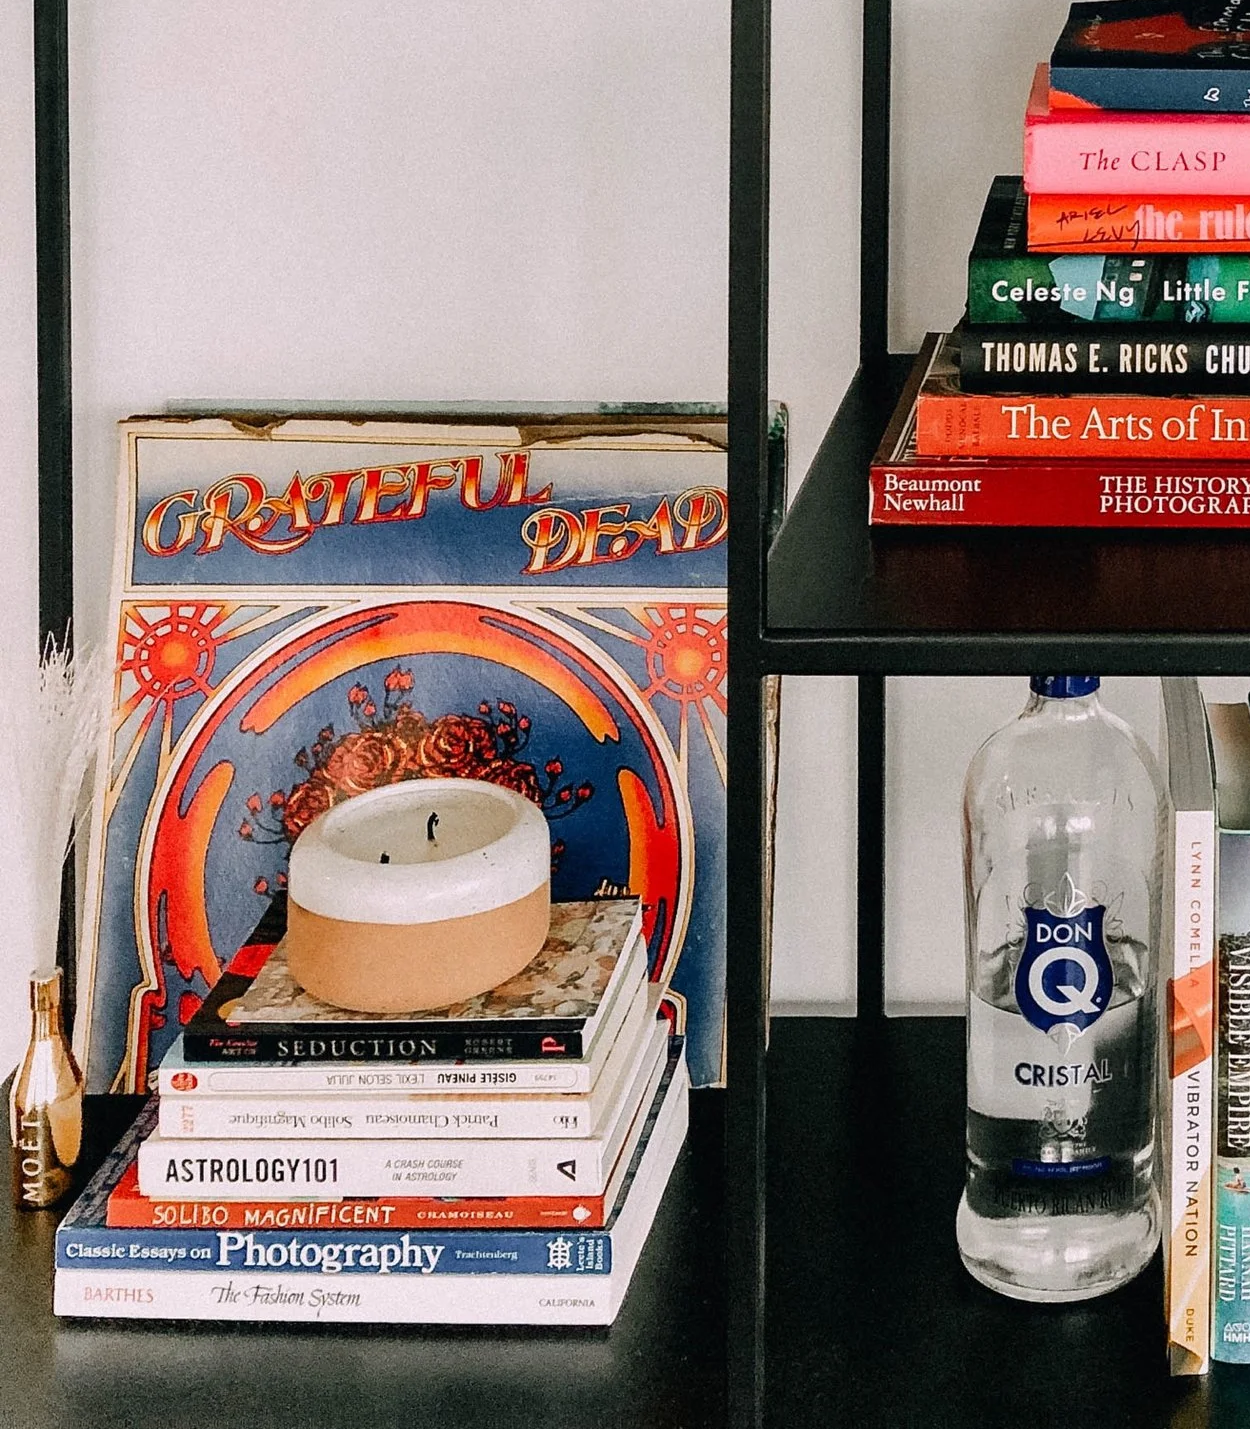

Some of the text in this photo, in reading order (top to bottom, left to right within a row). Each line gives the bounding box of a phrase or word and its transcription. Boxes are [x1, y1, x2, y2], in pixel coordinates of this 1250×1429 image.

[1080, 151, 1122, 172] The
[1131, 151, 1227, 173] CLASP
[1134, 204, 1183, 242] the
[991, 280, 1088, 304] Celeste
[1097, 280, 1135, 307] Ng
[1163, 278, 1227, 303] Little
[981, 341, 1078, 374] THOMAS
[1089, 343, 1109, 374] E.
[1119, 342, 1189, 374] RICKS
[1001, 404, 1071, 441] The
[1080, 406, 1153, 442] Arts
[1163, 403, 1205, 442] of
[883, 473, 982, 493] Beaumont
[1099, 475, 1149, 497] THE
[141, 450, 729, 575] GRATEFUL DEAD
[883, 493, 965, 513] Newhall
[1188, 840, 1202, 989] LYNN COMELLA
[1036, 922, 1093, 943] DON
[1028, 946, 1101, 1016] Q
[277, 1037, 438, 1058] SEDUCTION
[1014, 1058, 1113, 1088] CRISTAL
[1185, 1070, 1202, 1258] VIBRATOR NATION
[152, 1203, 514, 1226] SOLIBO MAGNIFICENT CHAMOISEAU
[65, 1231, 519, 1274] Classic Essays on Photography Trachtenberg
[1218, 1223, 1237, 1303] PITTARD
[84, 1281, 596, 1318] BARTHES The Fashion System CALIFORNIA
[1185, 1307, 1195, 1342] DUKE
